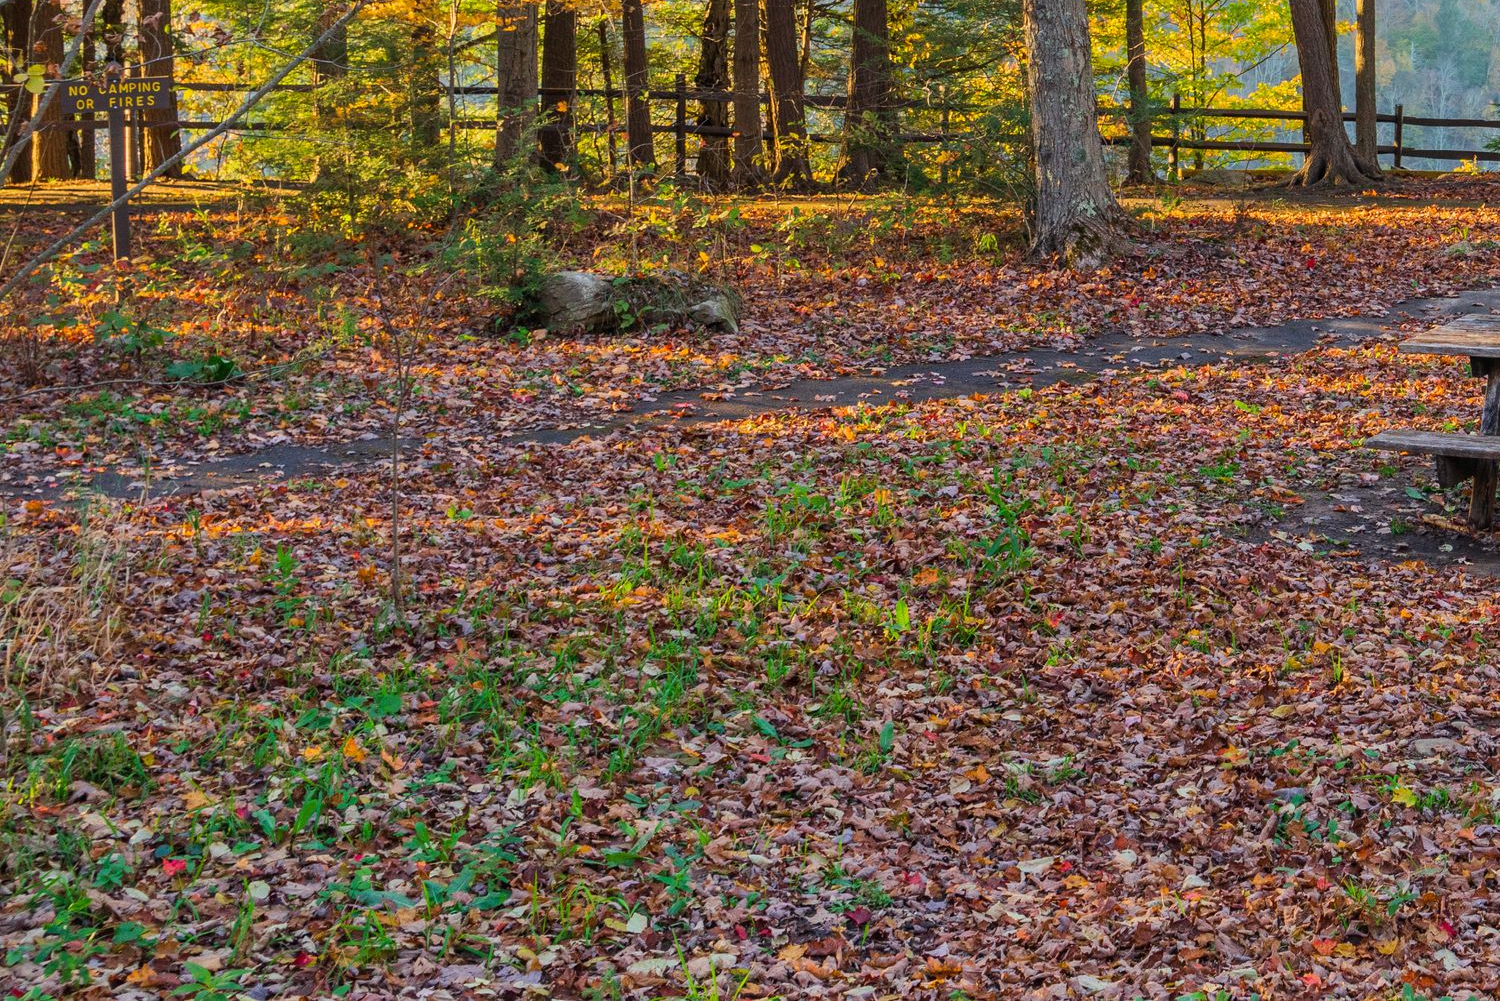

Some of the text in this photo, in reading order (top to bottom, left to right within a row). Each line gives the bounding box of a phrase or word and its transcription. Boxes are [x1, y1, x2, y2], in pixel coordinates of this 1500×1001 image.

[68, 85, 88, 97] NO
[76, 95, 155, 110] OR FIRES
